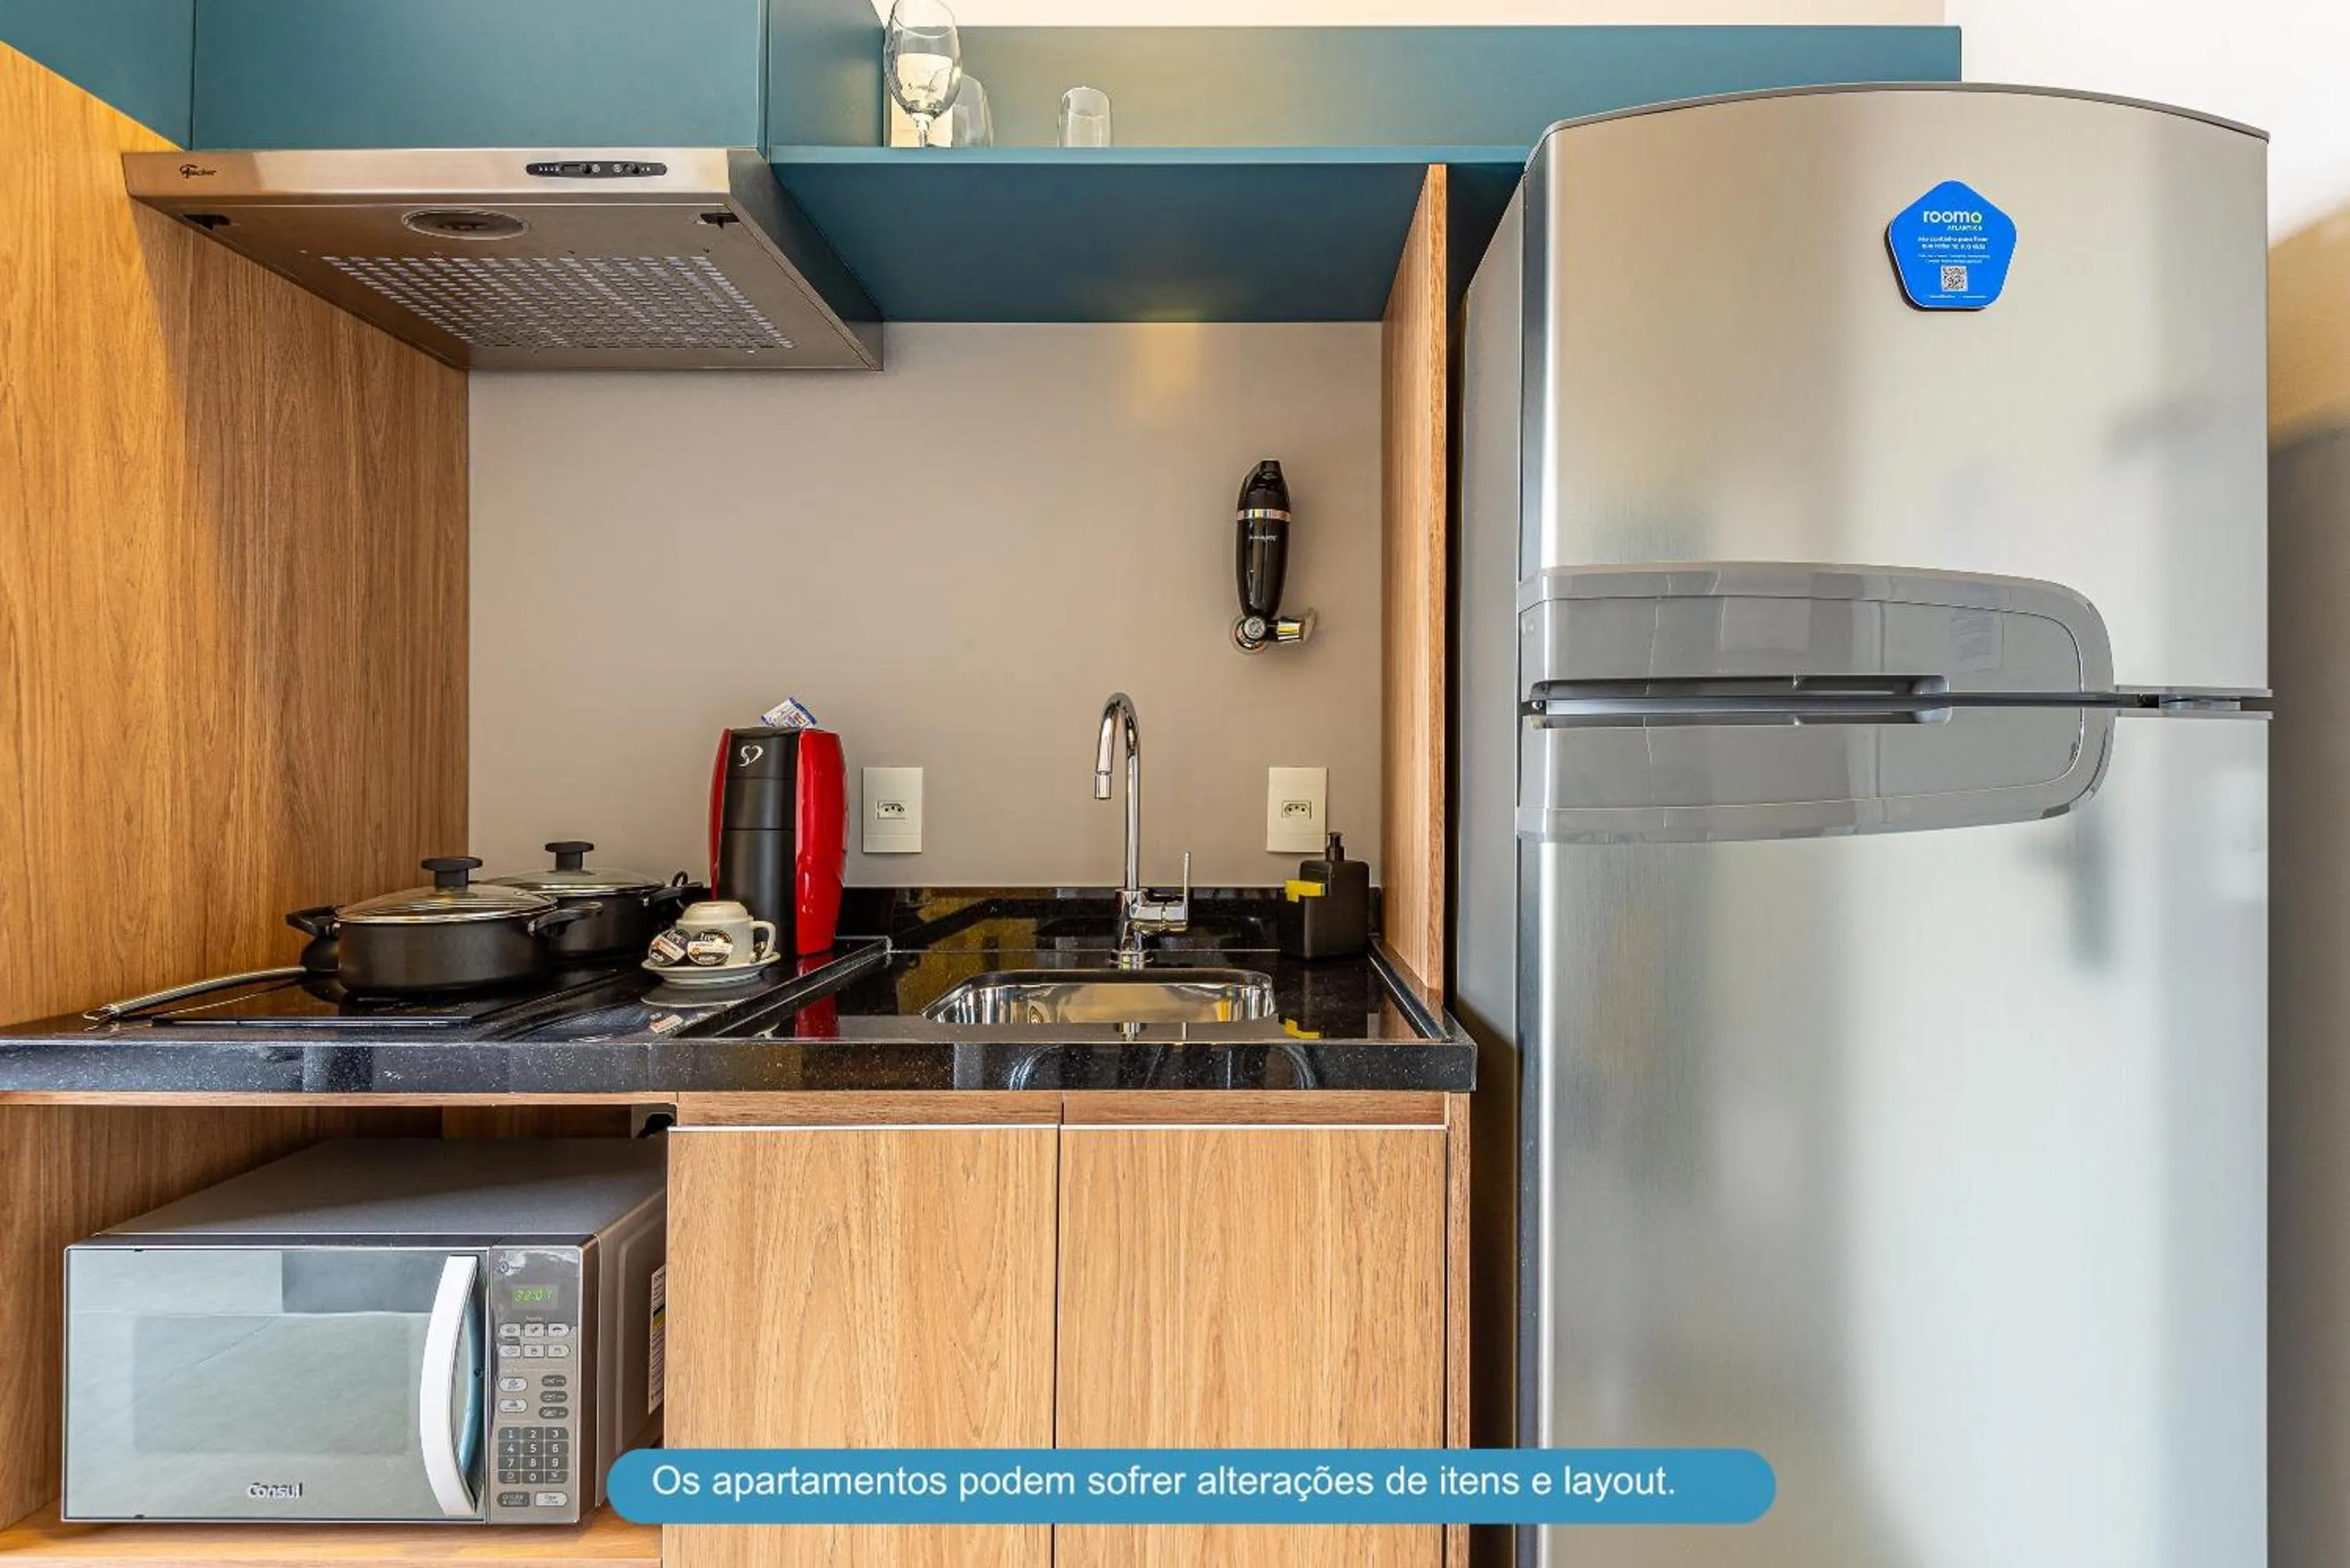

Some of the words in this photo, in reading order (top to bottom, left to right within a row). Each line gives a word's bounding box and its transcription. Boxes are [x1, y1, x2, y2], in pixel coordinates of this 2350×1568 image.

[1923, 210, 1982, 224] roomo
[507, 1429, 514, 1439] 1
[530, 1429, 537, 1439] 2
[552, 1429, 558, 1439] 3
[507, 1443, 515, 1453] 4
[530, 1443, 537, 1453] 5
[552, 1443, 558, 1453] 6
[507, 1457, 515, 1468] 7
[529, 1457, 537, 1468] 8
[552, 1457, 558, 1468] 9
[529, 1472, 537, 1482] 0
[248, 1482, 303, 1498] Consul
